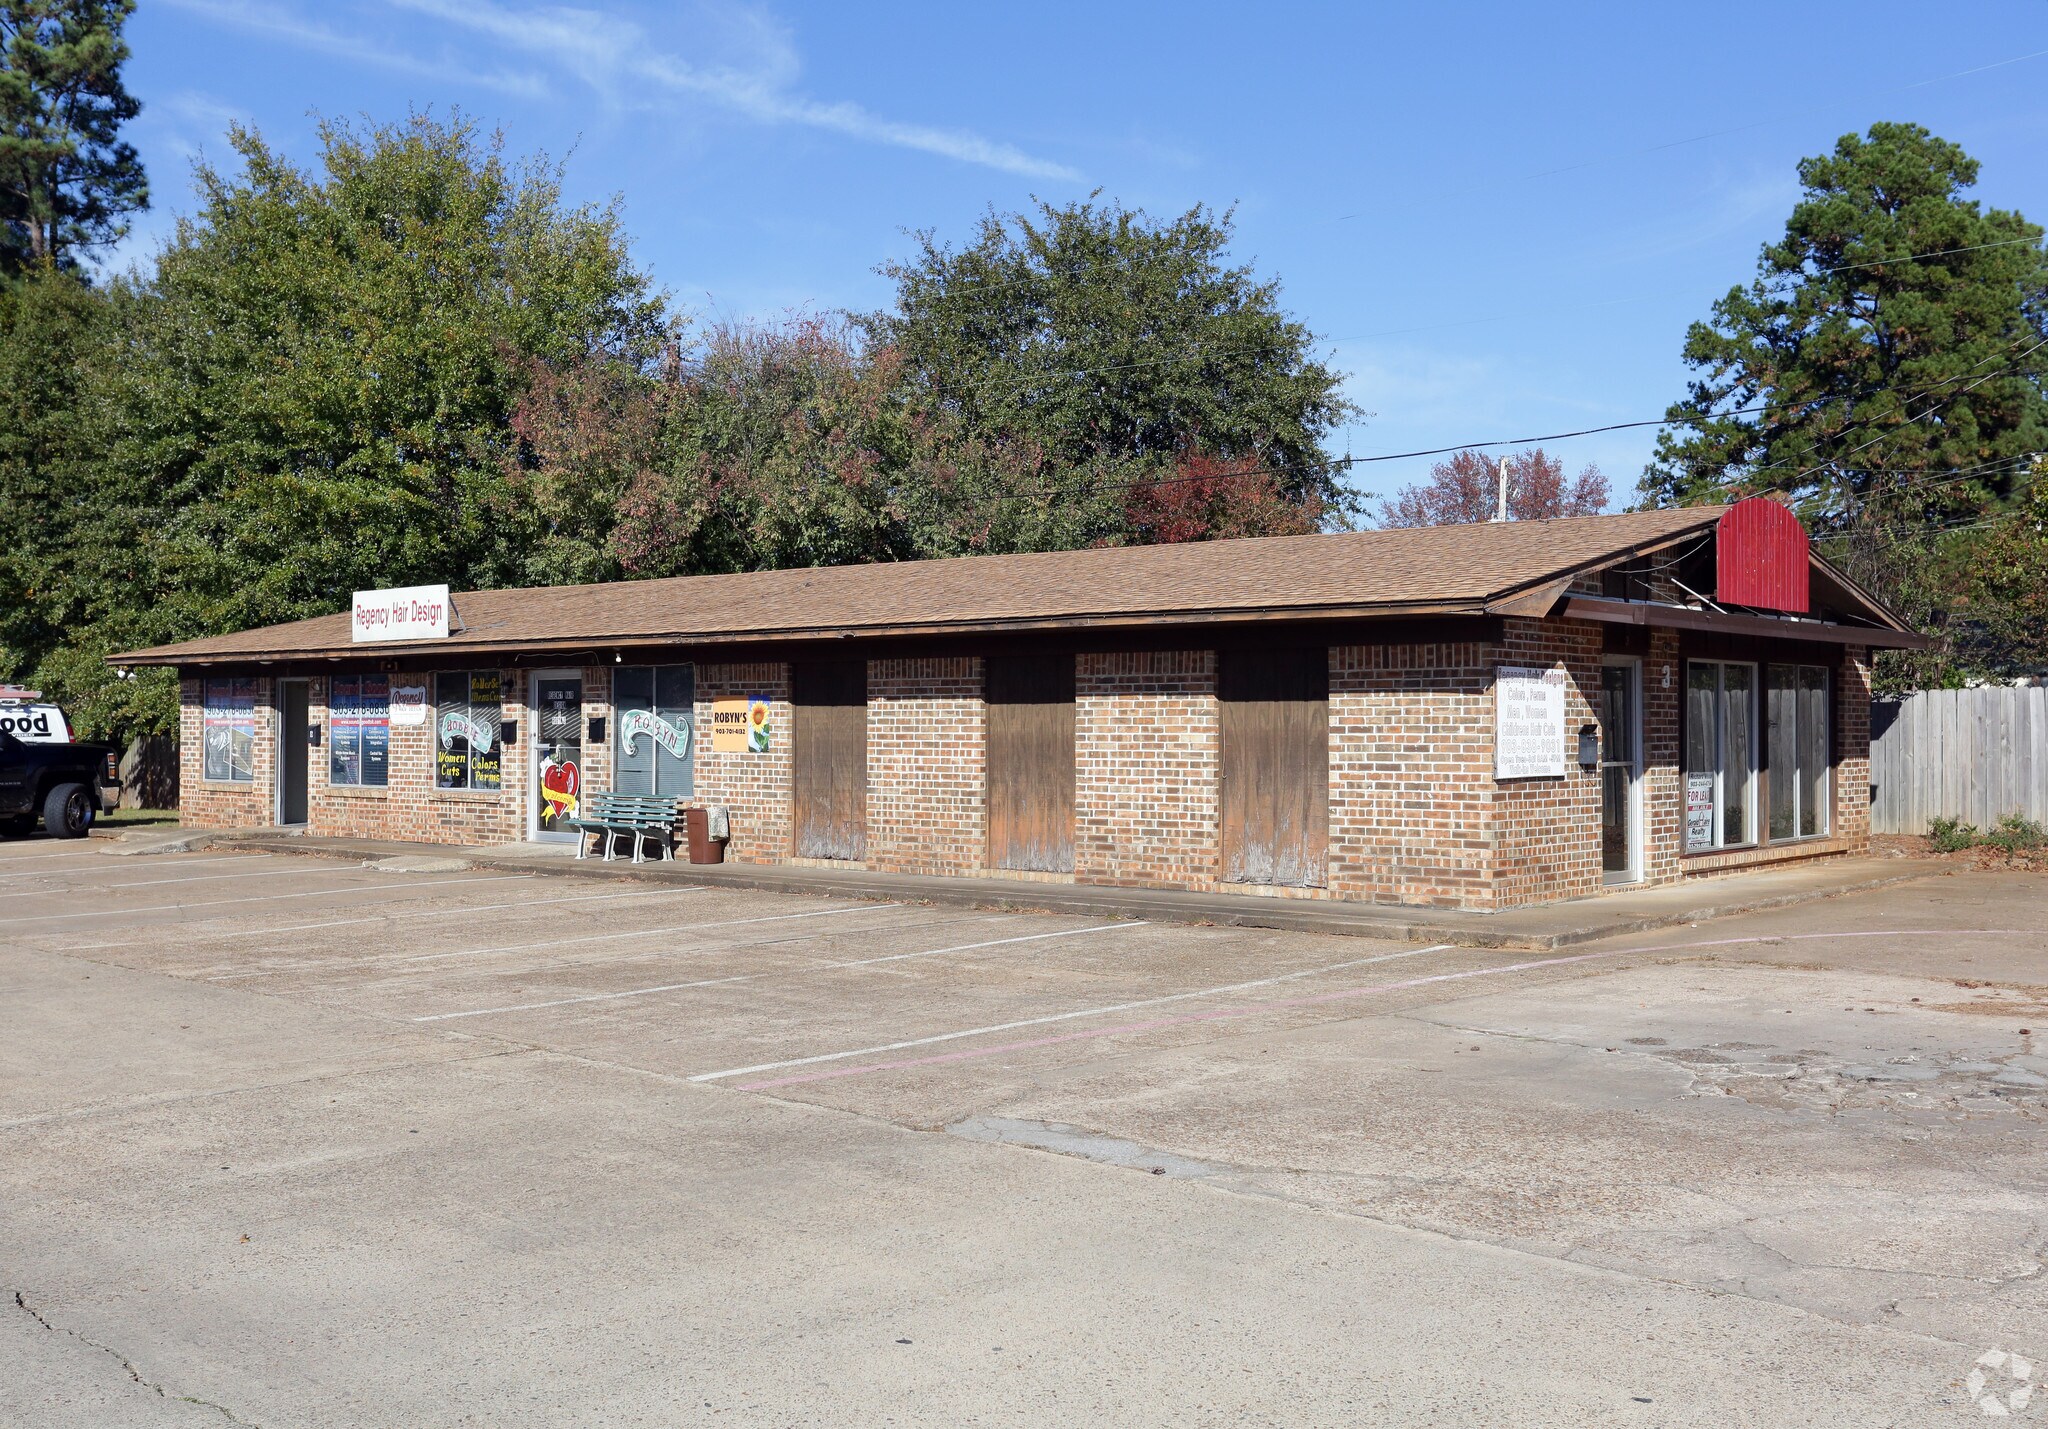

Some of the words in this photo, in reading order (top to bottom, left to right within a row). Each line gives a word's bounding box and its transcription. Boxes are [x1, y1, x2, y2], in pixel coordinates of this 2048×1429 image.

[357, 604, 389, 630] Regency
[392, 601, 408, 623] Hair
[411, 599, 442, 626] Design
[1497, 668, 1526, 686] Regency
[714, 712, 747, 723] ROBYN'S
[633, 715, 677, 749] ROBYN
[438, 751, 466, 763] Women
[471, 757, 498, 770] Colors
[441, 764, 460, 776] Cuts
[475, 770, 500, 782] Perms
[1688, 791, 1699, 802] FOR
